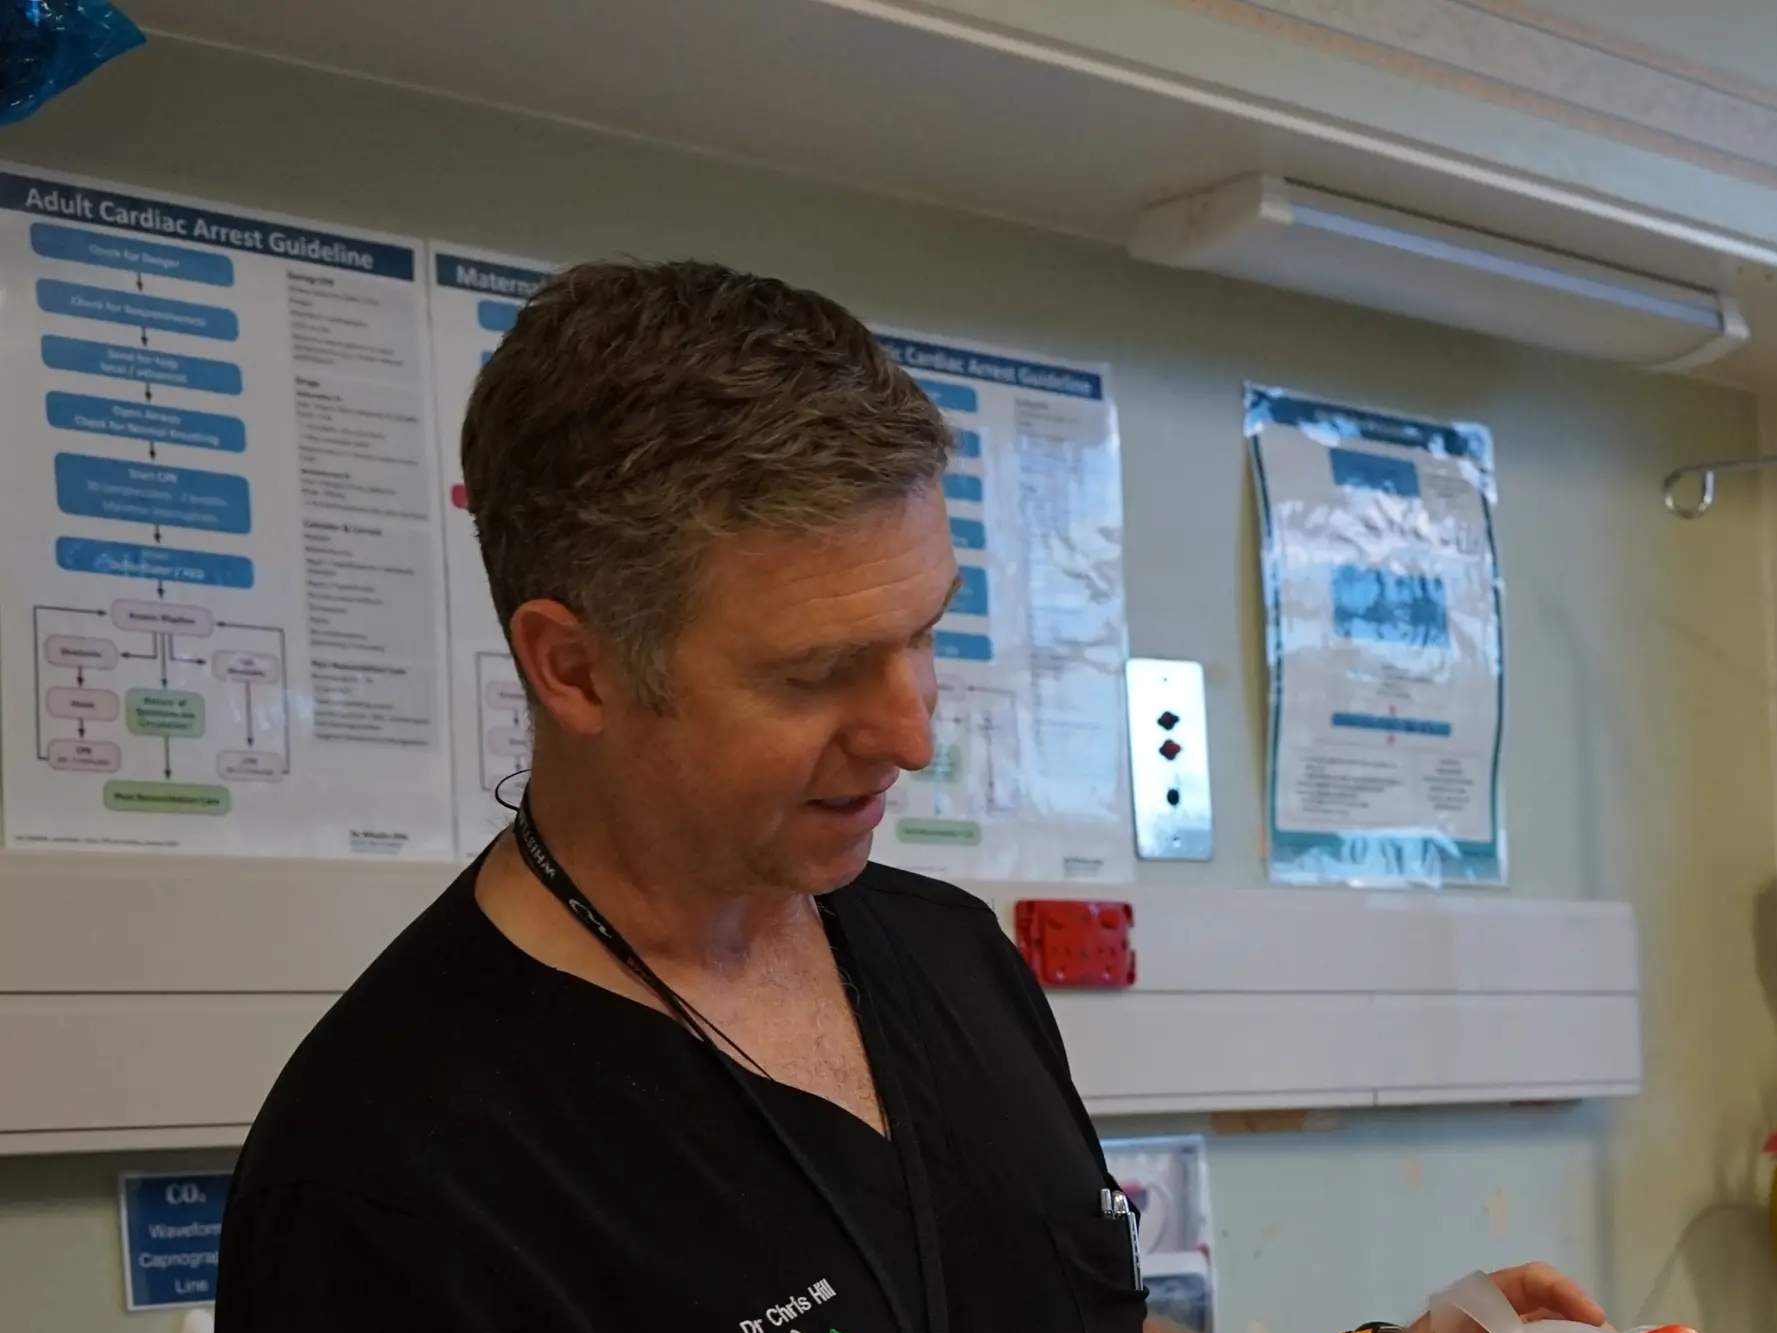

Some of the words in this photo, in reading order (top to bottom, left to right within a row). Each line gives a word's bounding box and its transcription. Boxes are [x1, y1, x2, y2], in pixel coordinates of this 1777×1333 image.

[26, 187, 94, 219] Adult
[100, 200, 187, 236] Cardiac
[193, 219, 263, 250] Arrest
[269, 232, 374, 270] Guideline
[174, 1278, 209, 1294] Line
[765, 1295, 812, 1327] Chris
[807, 1277, 837, 1305] Hill
